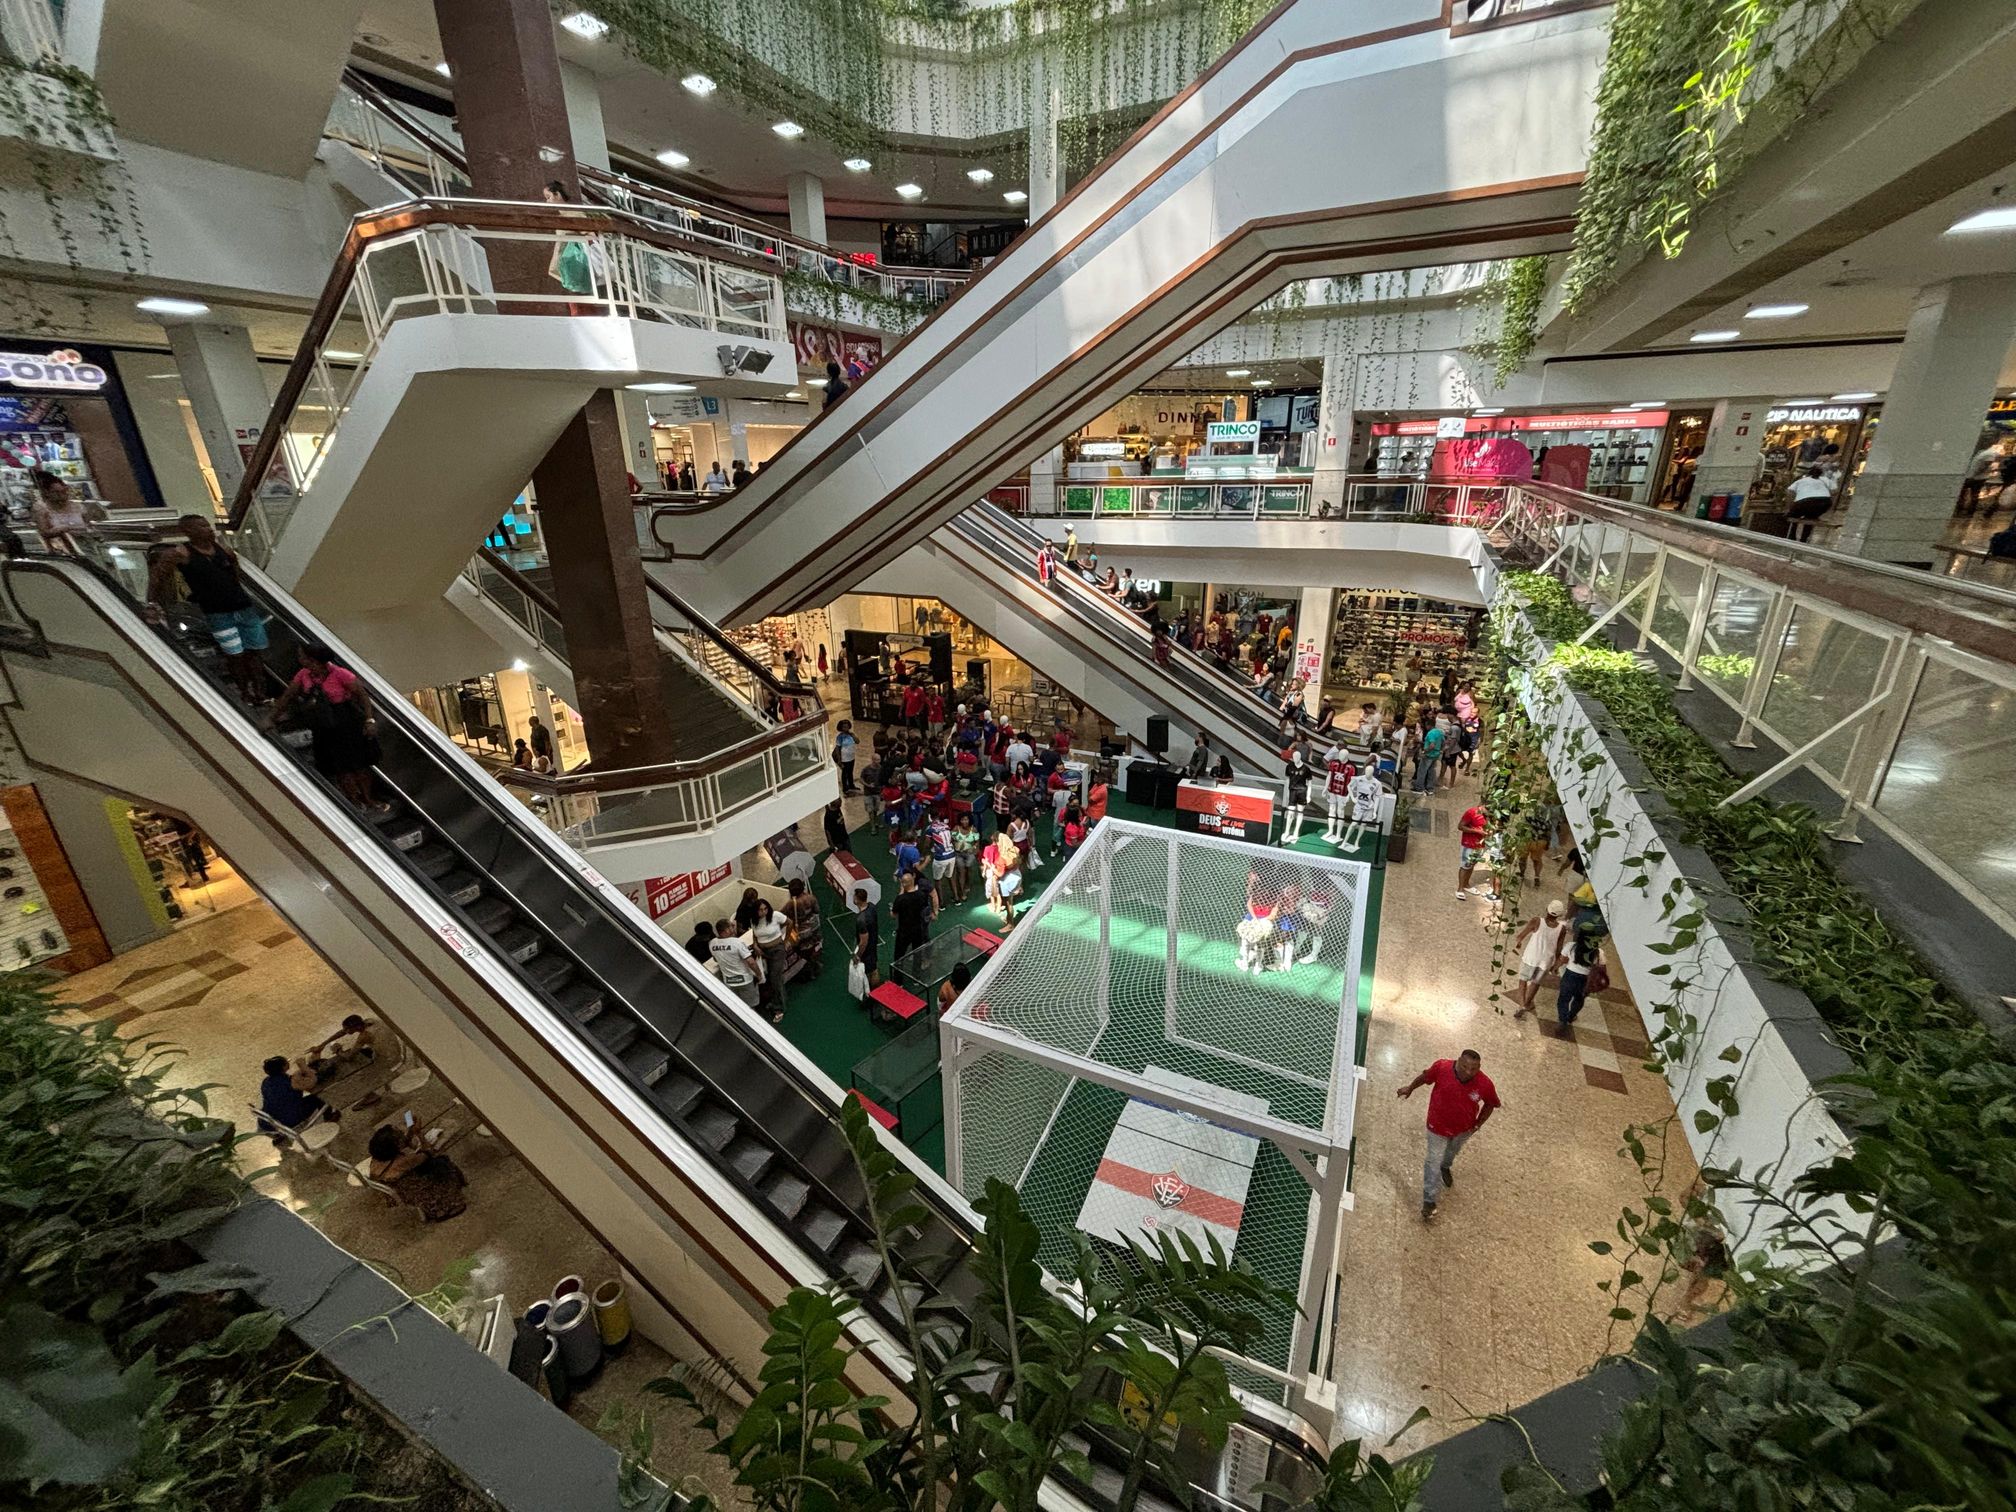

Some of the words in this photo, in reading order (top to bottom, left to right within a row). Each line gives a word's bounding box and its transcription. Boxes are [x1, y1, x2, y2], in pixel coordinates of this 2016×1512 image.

[1209, 423, 1258, 436] TRINCO
[1199, 813, 1221, 827] DEUS
[696, 869, 710, 889] 10
[653, 893, 670, 914] 10
